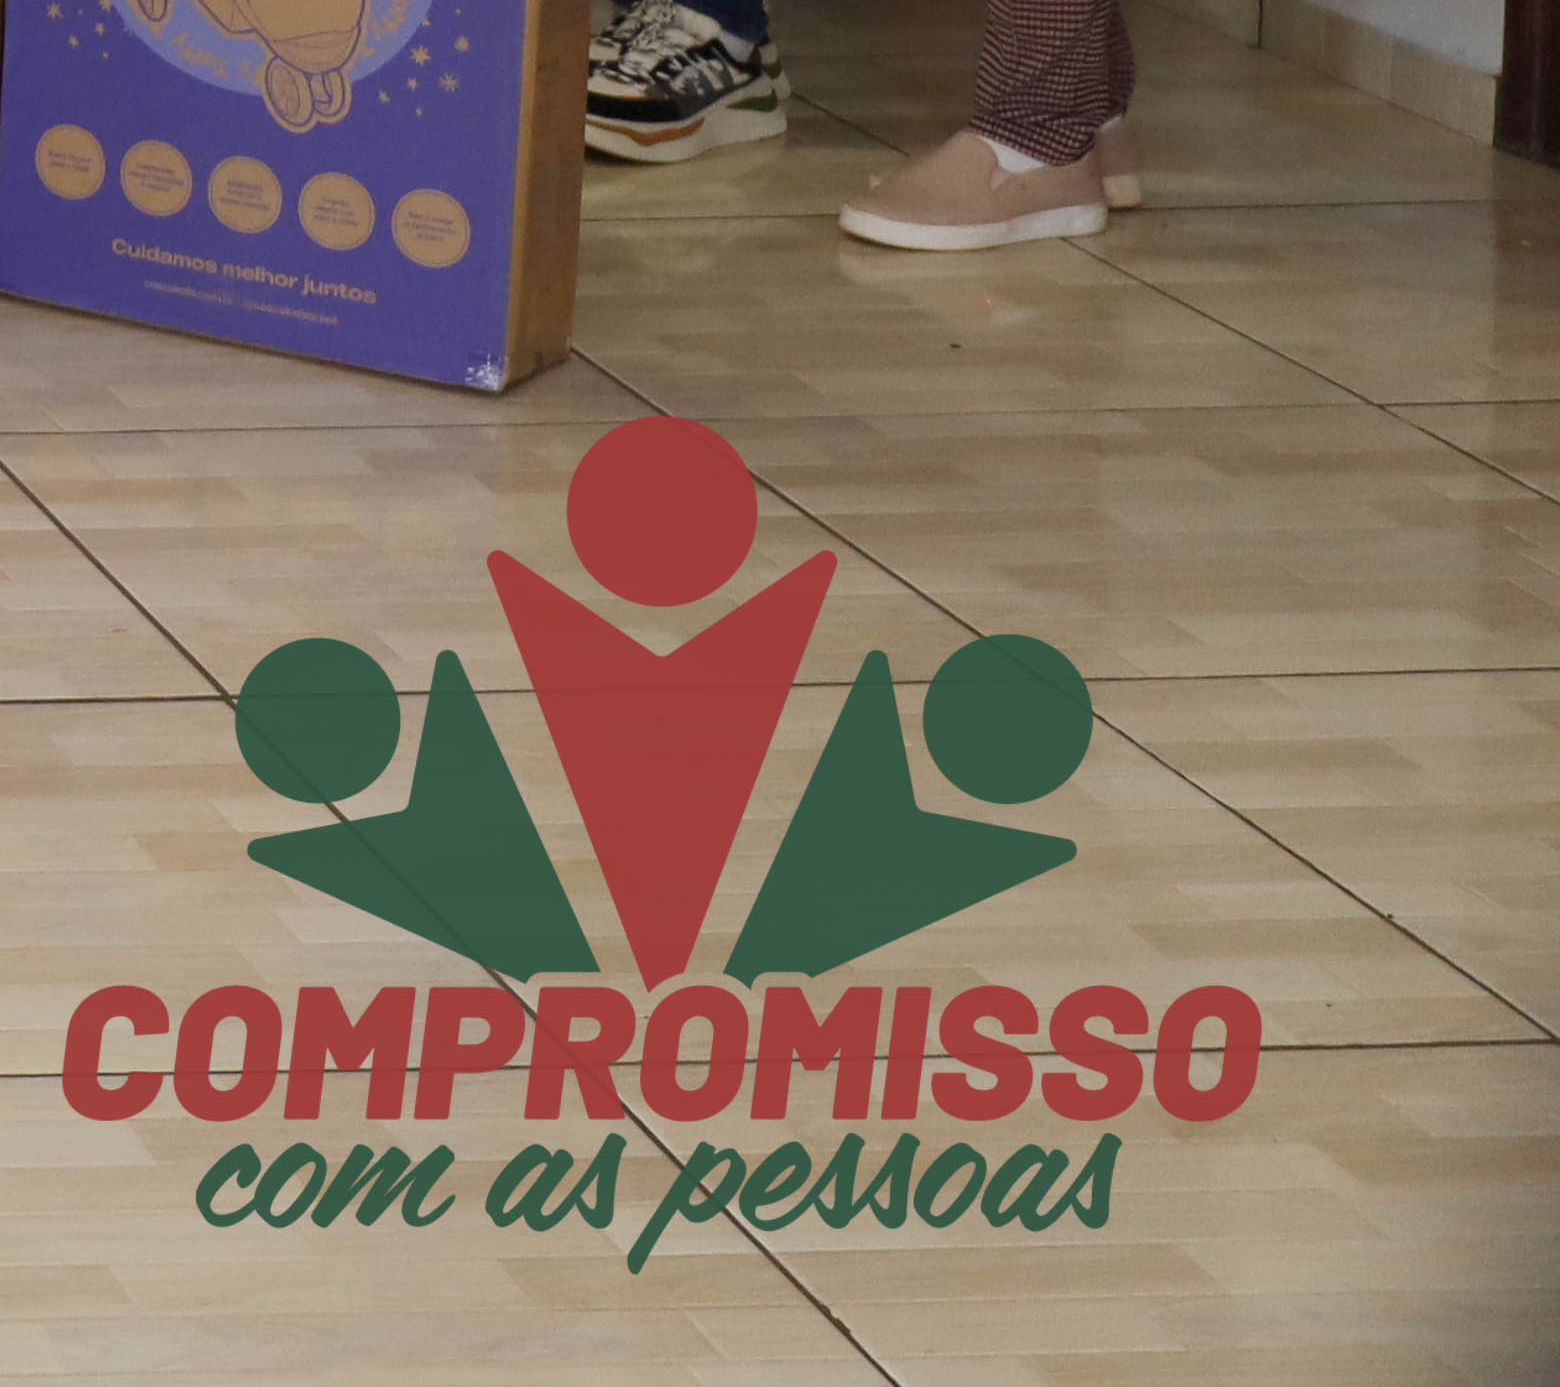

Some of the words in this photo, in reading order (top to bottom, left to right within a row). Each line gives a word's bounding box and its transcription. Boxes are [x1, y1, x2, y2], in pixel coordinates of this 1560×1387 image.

[112, 238, 220, 273] Cuidamos
[223, 263, 298, 288] melhor
[301, 274, 376, 304] juntos
